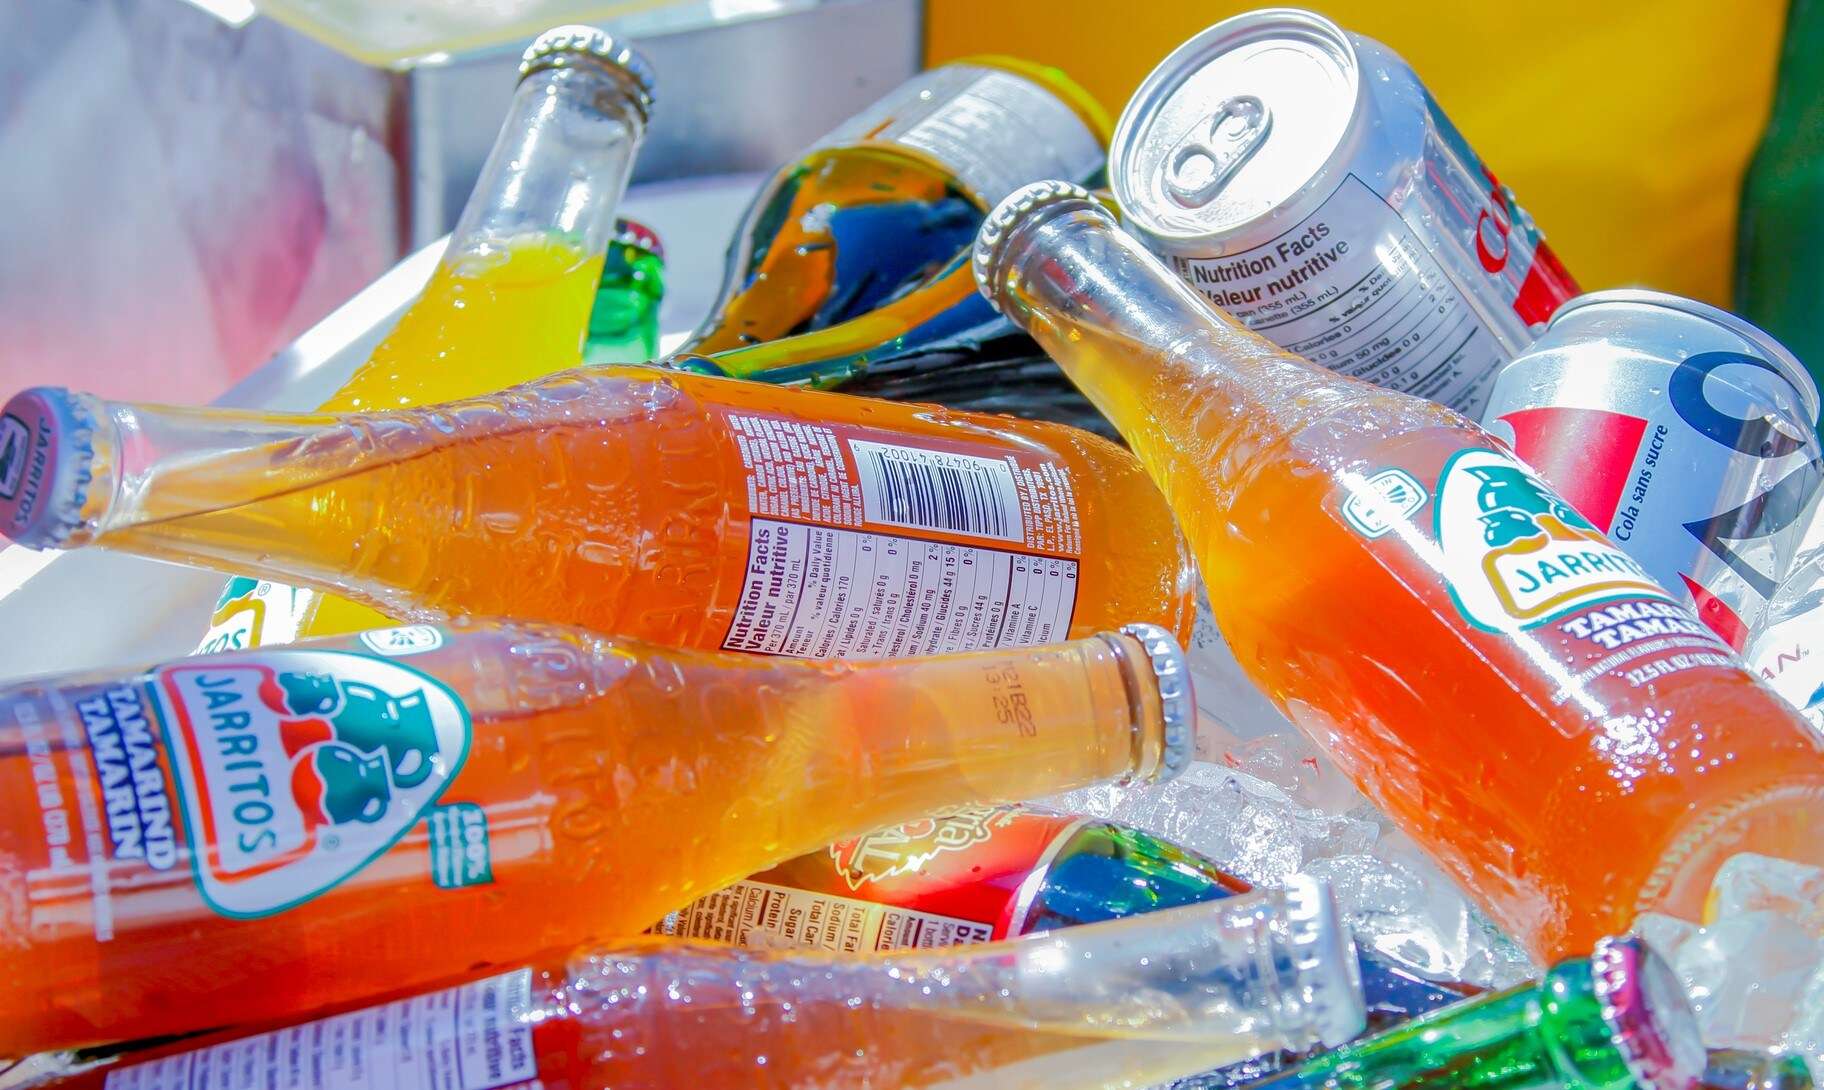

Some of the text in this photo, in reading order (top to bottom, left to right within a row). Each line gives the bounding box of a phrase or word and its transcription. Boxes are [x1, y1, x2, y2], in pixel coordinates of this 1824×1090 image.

[1194, 222, 1330, 283] Nutrition Facts
[1267, 240, 1350, 296] nutritive
[1285, 291, 1307, 305] mL)
[1316, 286, 1338, 302] mL)
[1343, 325, 1352, 333] 0
[1372, 338, 1390, 350] mg
[16, 416, 51, 524] JARRITOS
[853, 444, 1007, 473] 0 90478 41002 9
[1615, 424, 1668, 542] Cola sans sucre
[813, 530, 823, 555] Value
[929, 553, 938, 561] 2
[809, 555, 823, 579] Daily
[821, 532, 834, 583] quotidienne
[945, 557, 956, 569] 15
[726, 529, 771, 649] Nutrition Facts
[745, 526, 789, 650] Valeur nutritive
[943, 576, 954, 587] 44
[1066, 572, 1076, 580] 0
[765, 559, 801, 652] Per 370 mL par 370 mL
[815, 584, 828, 611] valeur
[900, 579, 918, 623] Cholestérol
[912, 560, 922, 573] mg
[926, 588, 936, 601] mg
[935, 588, 953, 621] Glucides
[974, 600, 985, 611] 44
[1005, 611, 1019, 643] Vitamine
[1016, 565, 1026, 573] 0
[815, 575, 850, 658] Calories Calories 170
[922, 602, 932, 613] 40
[842, 619, 858, 644] Lipides
[856, 621, 877, 654] Saturated
[872, 630, 888, 651] Trans
[882, 606, 895, 625] trans
[912, 611, 928, 640] Sodium
[951, 615, 963, 641] Fibres
[968, 611, 982, 638] Sucres
[1019, 611, 1036, 644] Vitamine
[786, 625, 804, 654] Amount
[795, 630, 814, 655] Teneur
[79, 694, 146, 862] TAMARIN
[106, 684, 180, 870] TAMARIND
[195, 673, 278, 854] JARRITOS
[461, 808, 488, 884] 100%
[744, 888, 762, 921] Calcium
[766, 891, 786, 929] Protein
[809, 900, 825, 925] Total
[824, 903, 846, 942] Sodium
[850, 907, 865, 935] Total
